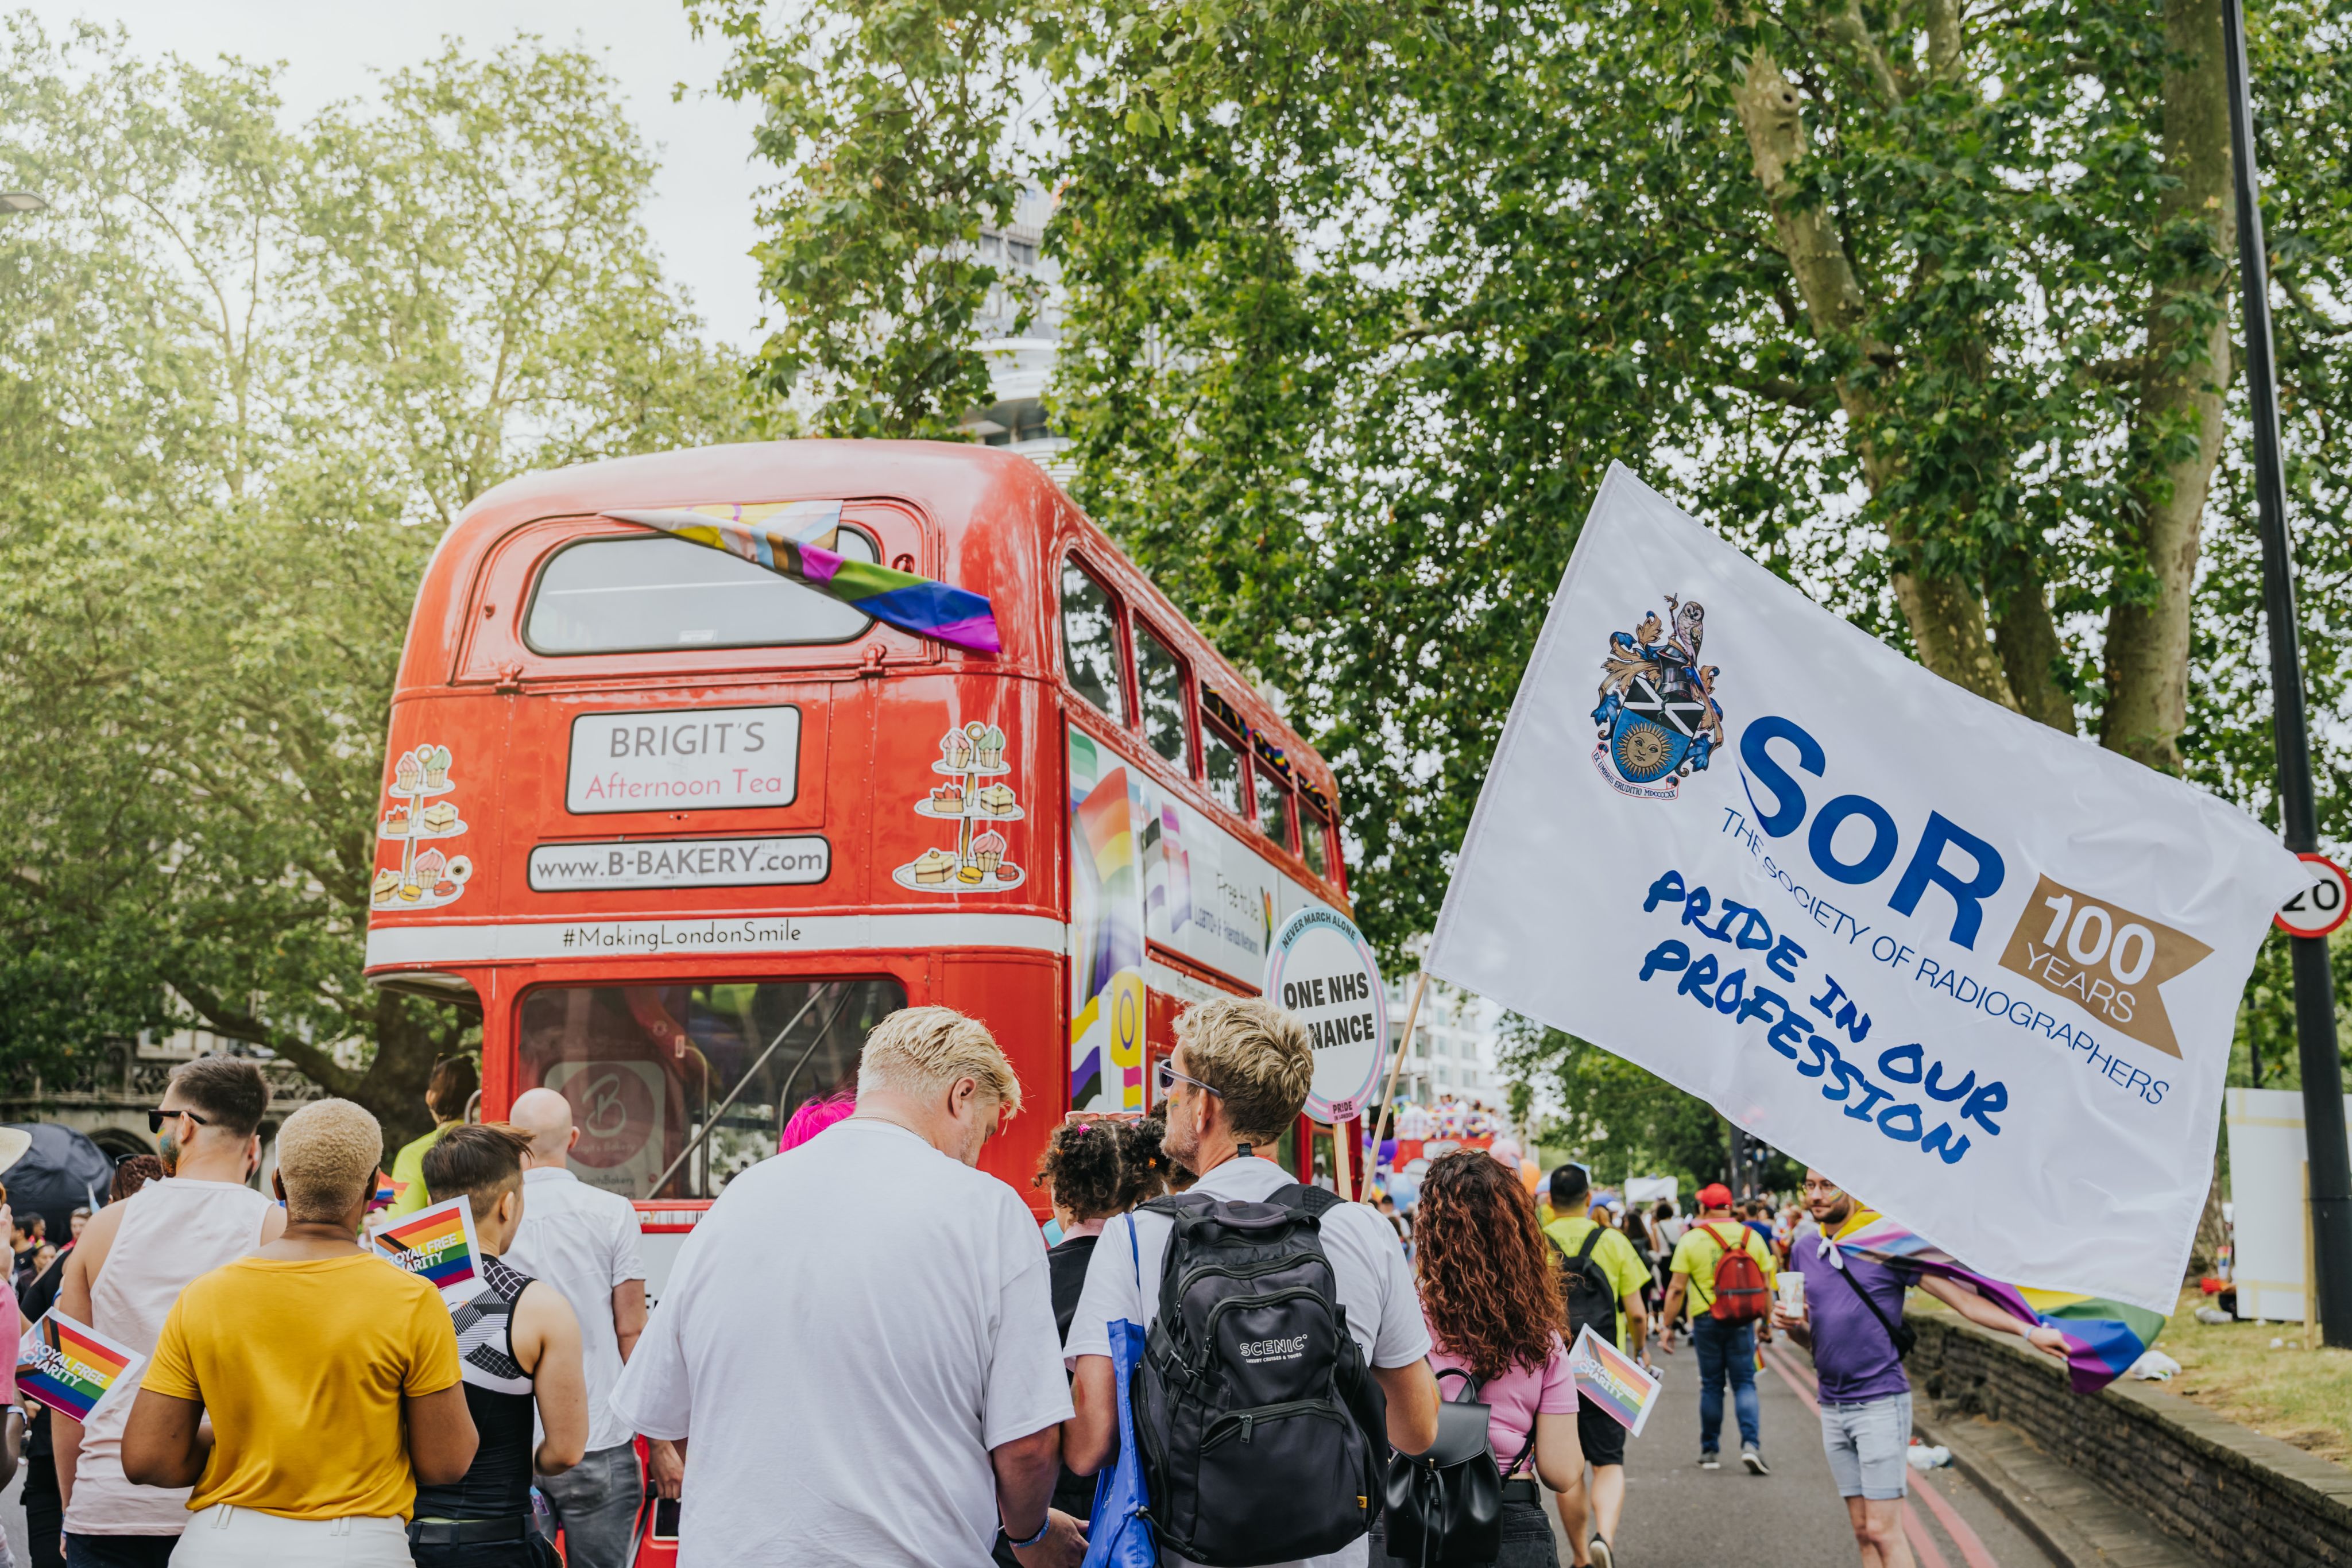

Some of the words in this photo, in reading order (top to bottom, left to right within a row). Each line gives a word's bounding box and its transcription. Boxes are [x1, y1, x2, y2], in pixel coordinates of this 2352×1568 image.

[610, 721, 765, 758] BRIGIT'S
[585, 772, 721, 799] Afternoon
[732, 768, 782, 793] Tea
[1593, 752, 1600, 763] EX
[1597, 761, 1615, 784] UMBRIS
[1614, 780, 1642, 796] ERUDITIO
[1740, 716, 2005, 951] SoR
[537, 846, 823, 878] www.B-BAKERY.com
[563, 918, 802, 951] #MakingLondonSmile
[1282, 919, 1304, 948] NEVER
[1303, 912, 1331, 926] MARCH
[1332, 915, 1356, 940] ALONE
[2044, 893, 2156, 985] 100
[1723, 807, 1764, 862] THE
[1763, 856, 1871, 944] SOCIETY
[1872, 936, 1915, 968] OF
[1915, 958, 2170, 1105] RADIOGRAPHERS
[1283, 978, 1325, 1011] ONE
[1328, 972, 1369, 1004] NHS
[1643, 870, 1808, 984] PRIDE
[1810, 974, 1872, 1043] IN
[1878, 1043, 2008, 1136] OUR
[2027, 942, 2136, 1023] YEARS
[1639, 939, 1971, 1164] PROFESSION
[386, 1245, 426, 1264] ROYAL
[426, 1233, 458, 1253] FREE
[22, 1351, 83, 1387] CHARITY
[30, 1339, 71, 1369] ROYAL
[72, 1361, 107, 1385] FREE
[1579, 1362, 1624, 1400] CHARITY
[1584, 1352, 1615, 1380] ROYAL
[1614, 1377, 1641, 1403] FREE
